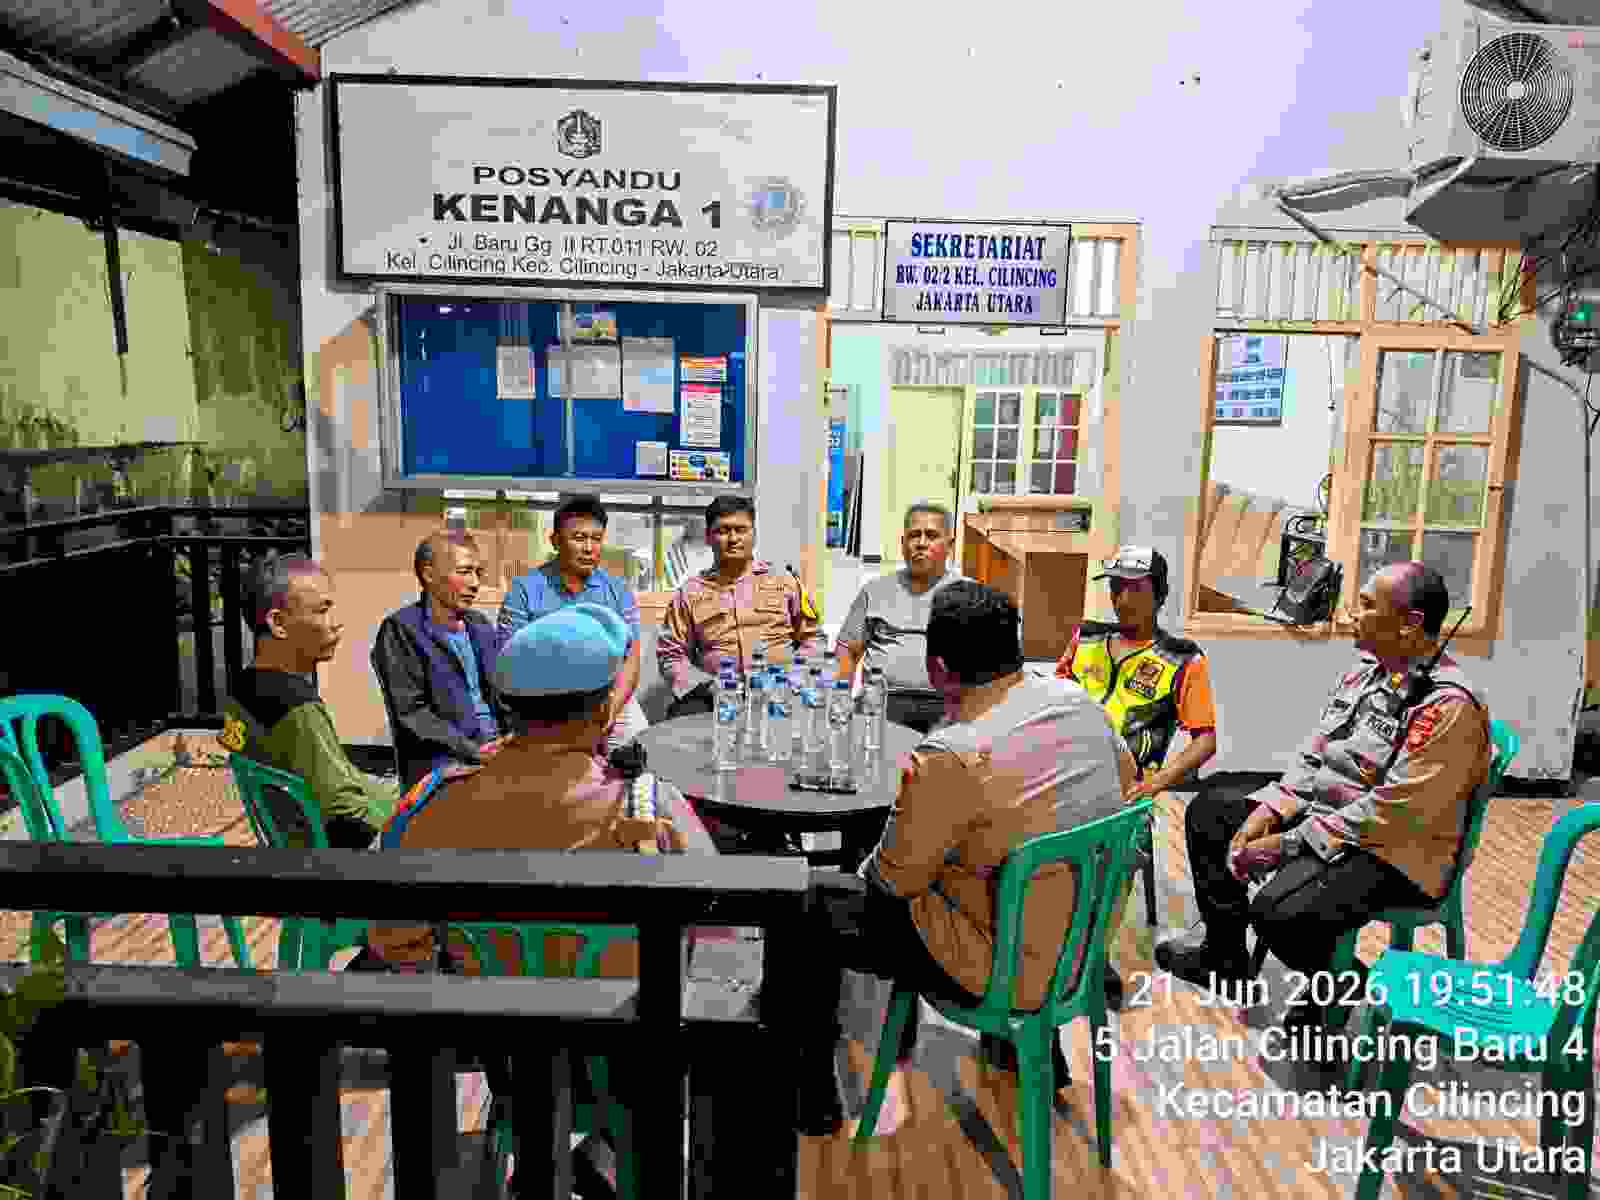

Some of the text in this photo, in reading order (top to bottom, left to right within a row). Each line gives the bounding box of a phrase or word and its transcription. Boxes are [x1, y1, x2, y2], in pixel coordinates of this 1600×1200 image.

[473, 166, 681, 191] POSYANDU
[432, 193, 683, 228] KENANGA
[701, 200, 721, 229] 1
[474, 233, 518, 251] Baru
[911, 231, 1047, 260] SEKRETARIAT
[429, 253, 505, 273] Cilincing
[560, 257, 637, 279] Cilincing
[988, 267, 1057, 289] CILINCING
[915, 290, 1034, 315] JAKARTA UTARA
